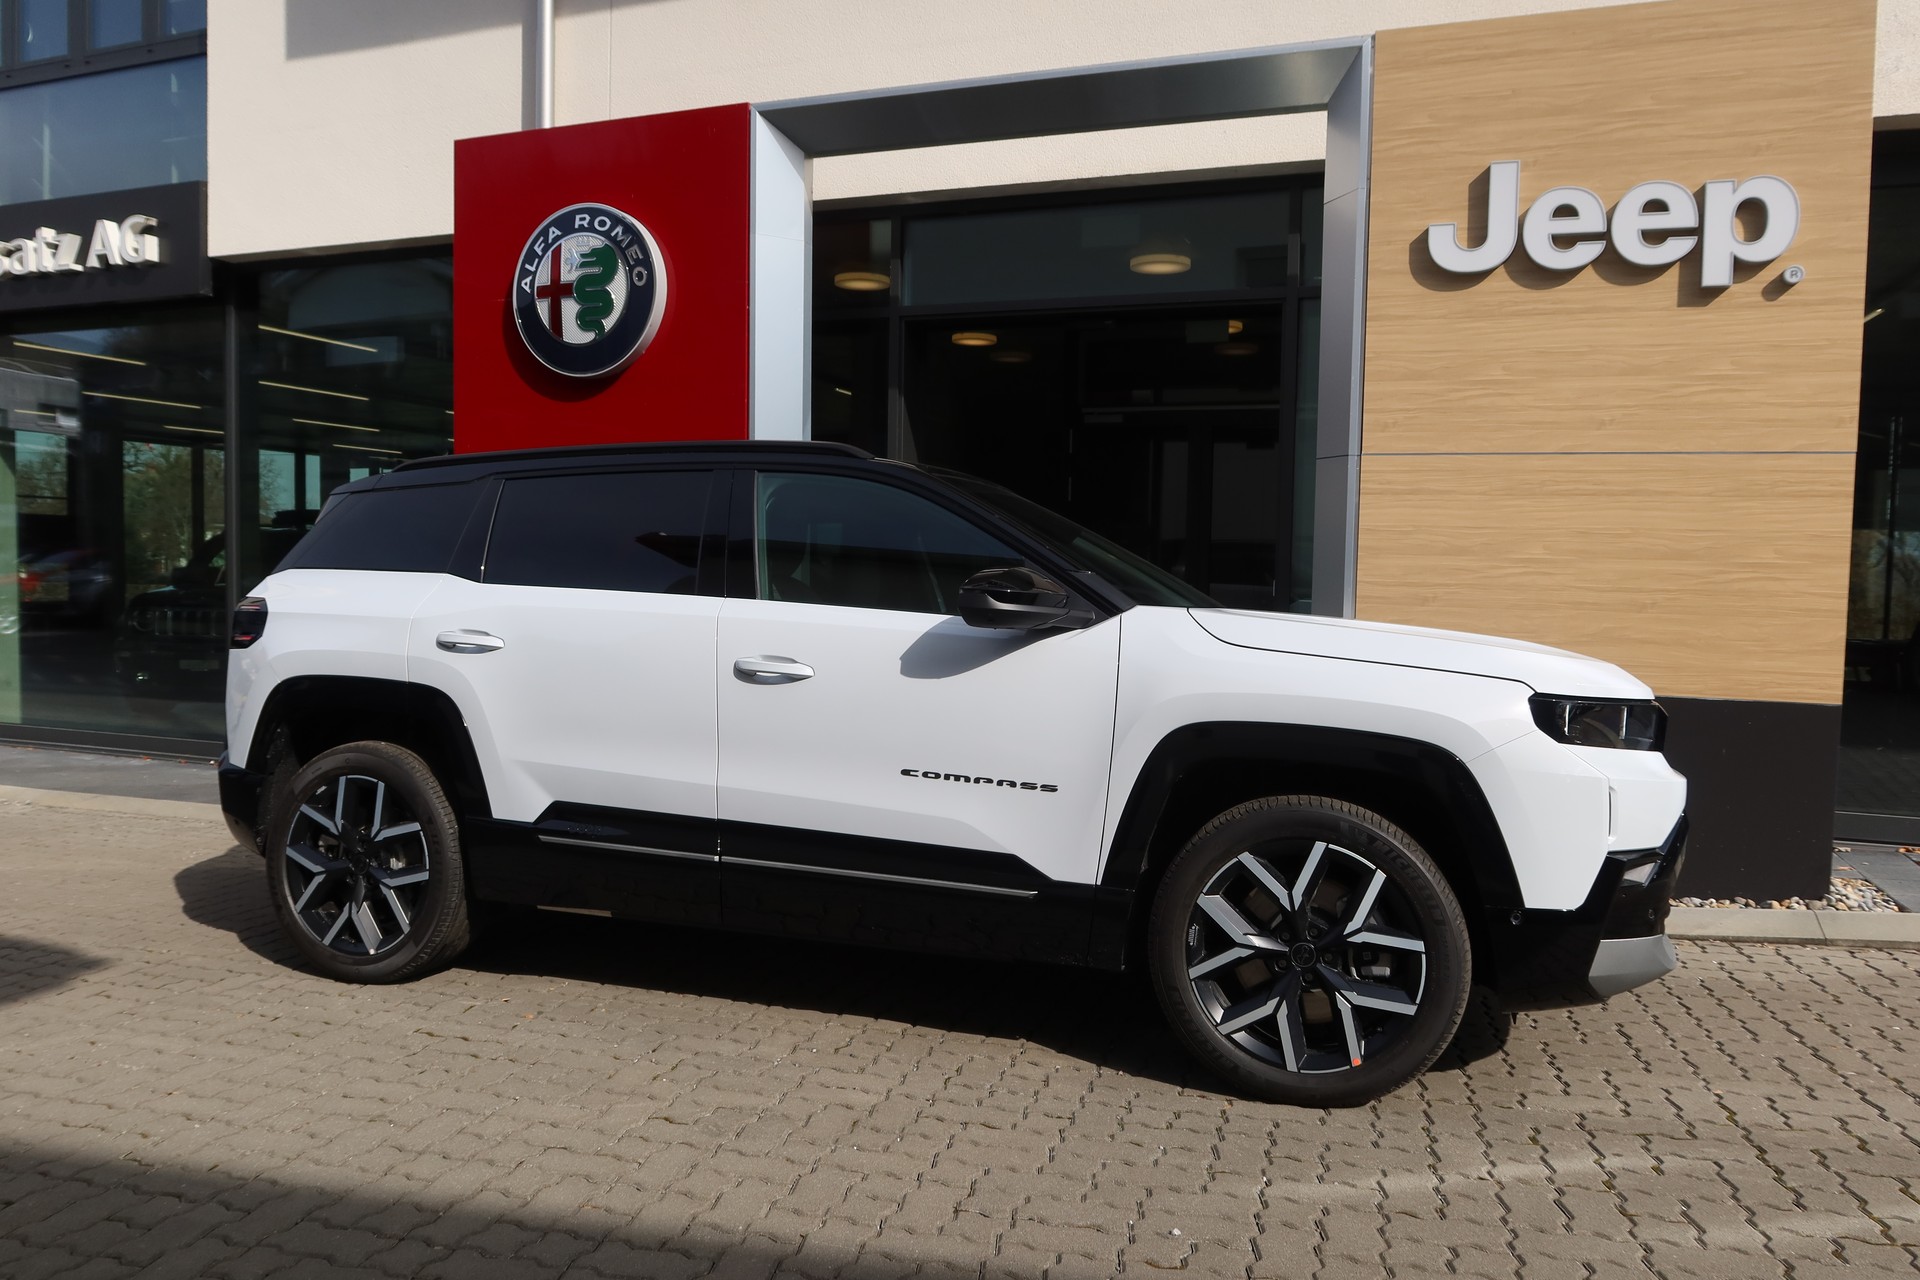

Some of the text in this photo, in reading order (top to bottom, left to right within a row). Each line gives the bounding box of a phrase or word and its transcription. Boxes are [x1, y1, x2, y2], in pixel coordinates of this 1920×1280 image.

[86, 214, 160, 268] AG
[521, 213, 648, 293] ALFA ROMEO
[1428, 160, 1800, 287] Jeep
